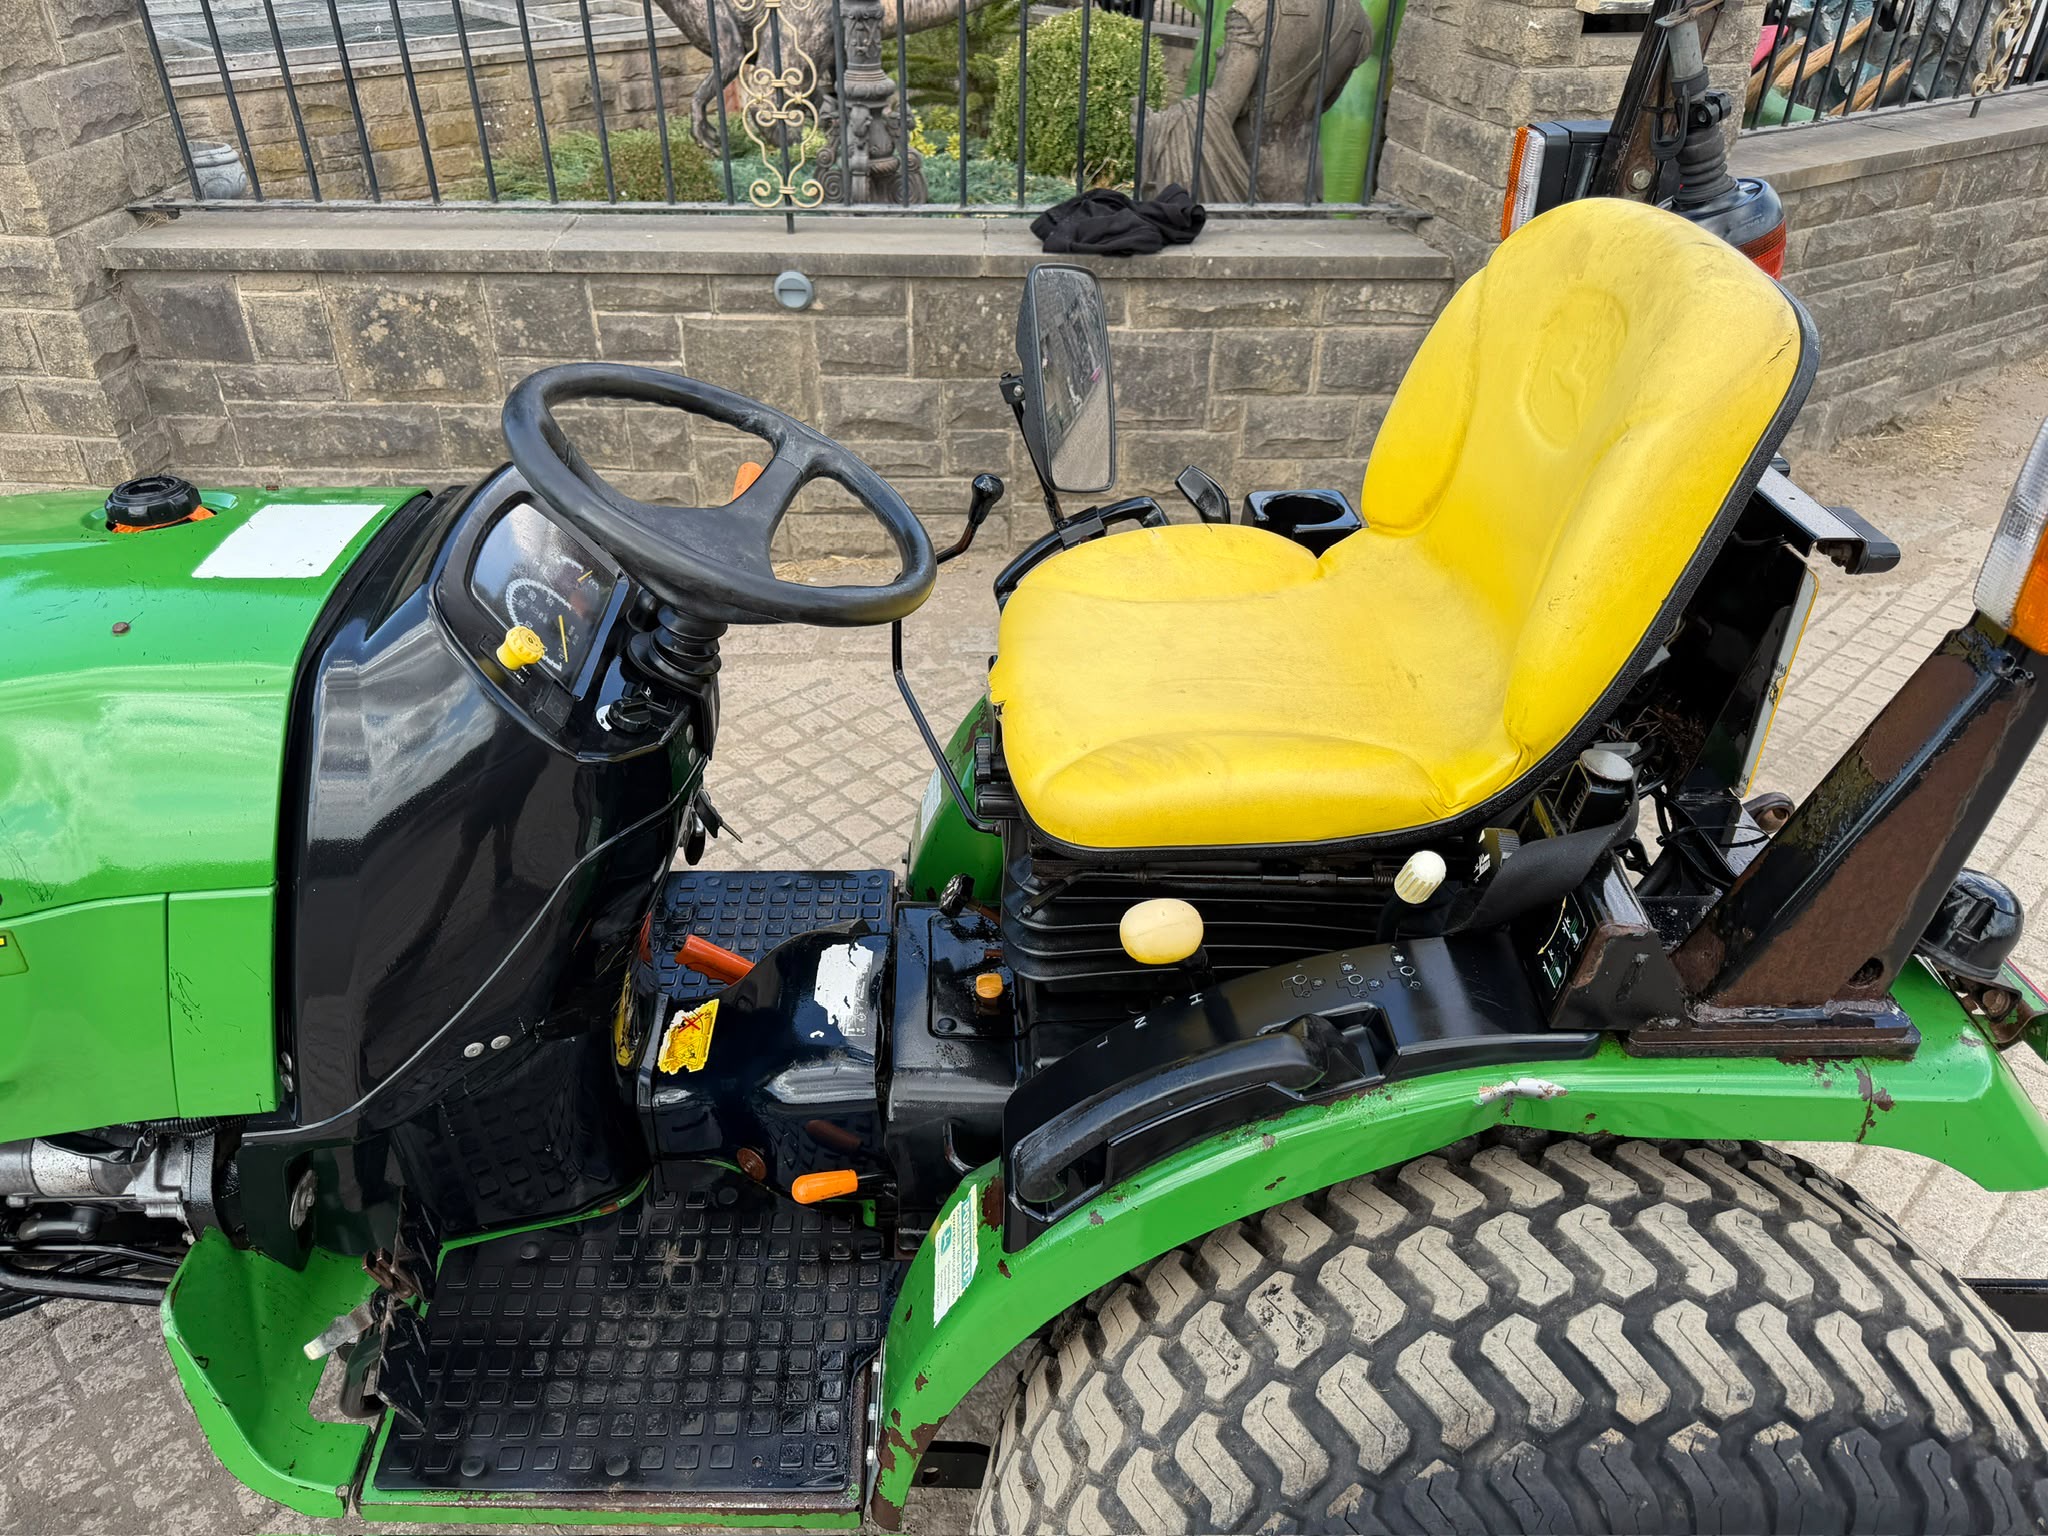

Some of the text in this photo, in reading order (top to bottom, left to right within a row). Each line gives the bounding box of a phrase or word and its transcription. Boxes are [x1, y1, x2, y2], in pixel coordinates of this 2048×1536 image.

[1188, 992, 1203, 1006] H
[1134, 1015, 1147, 1029] N
[1096, 1035, 1109, 1048] L
[962, 1201, 971, 1282] POWERCUT
